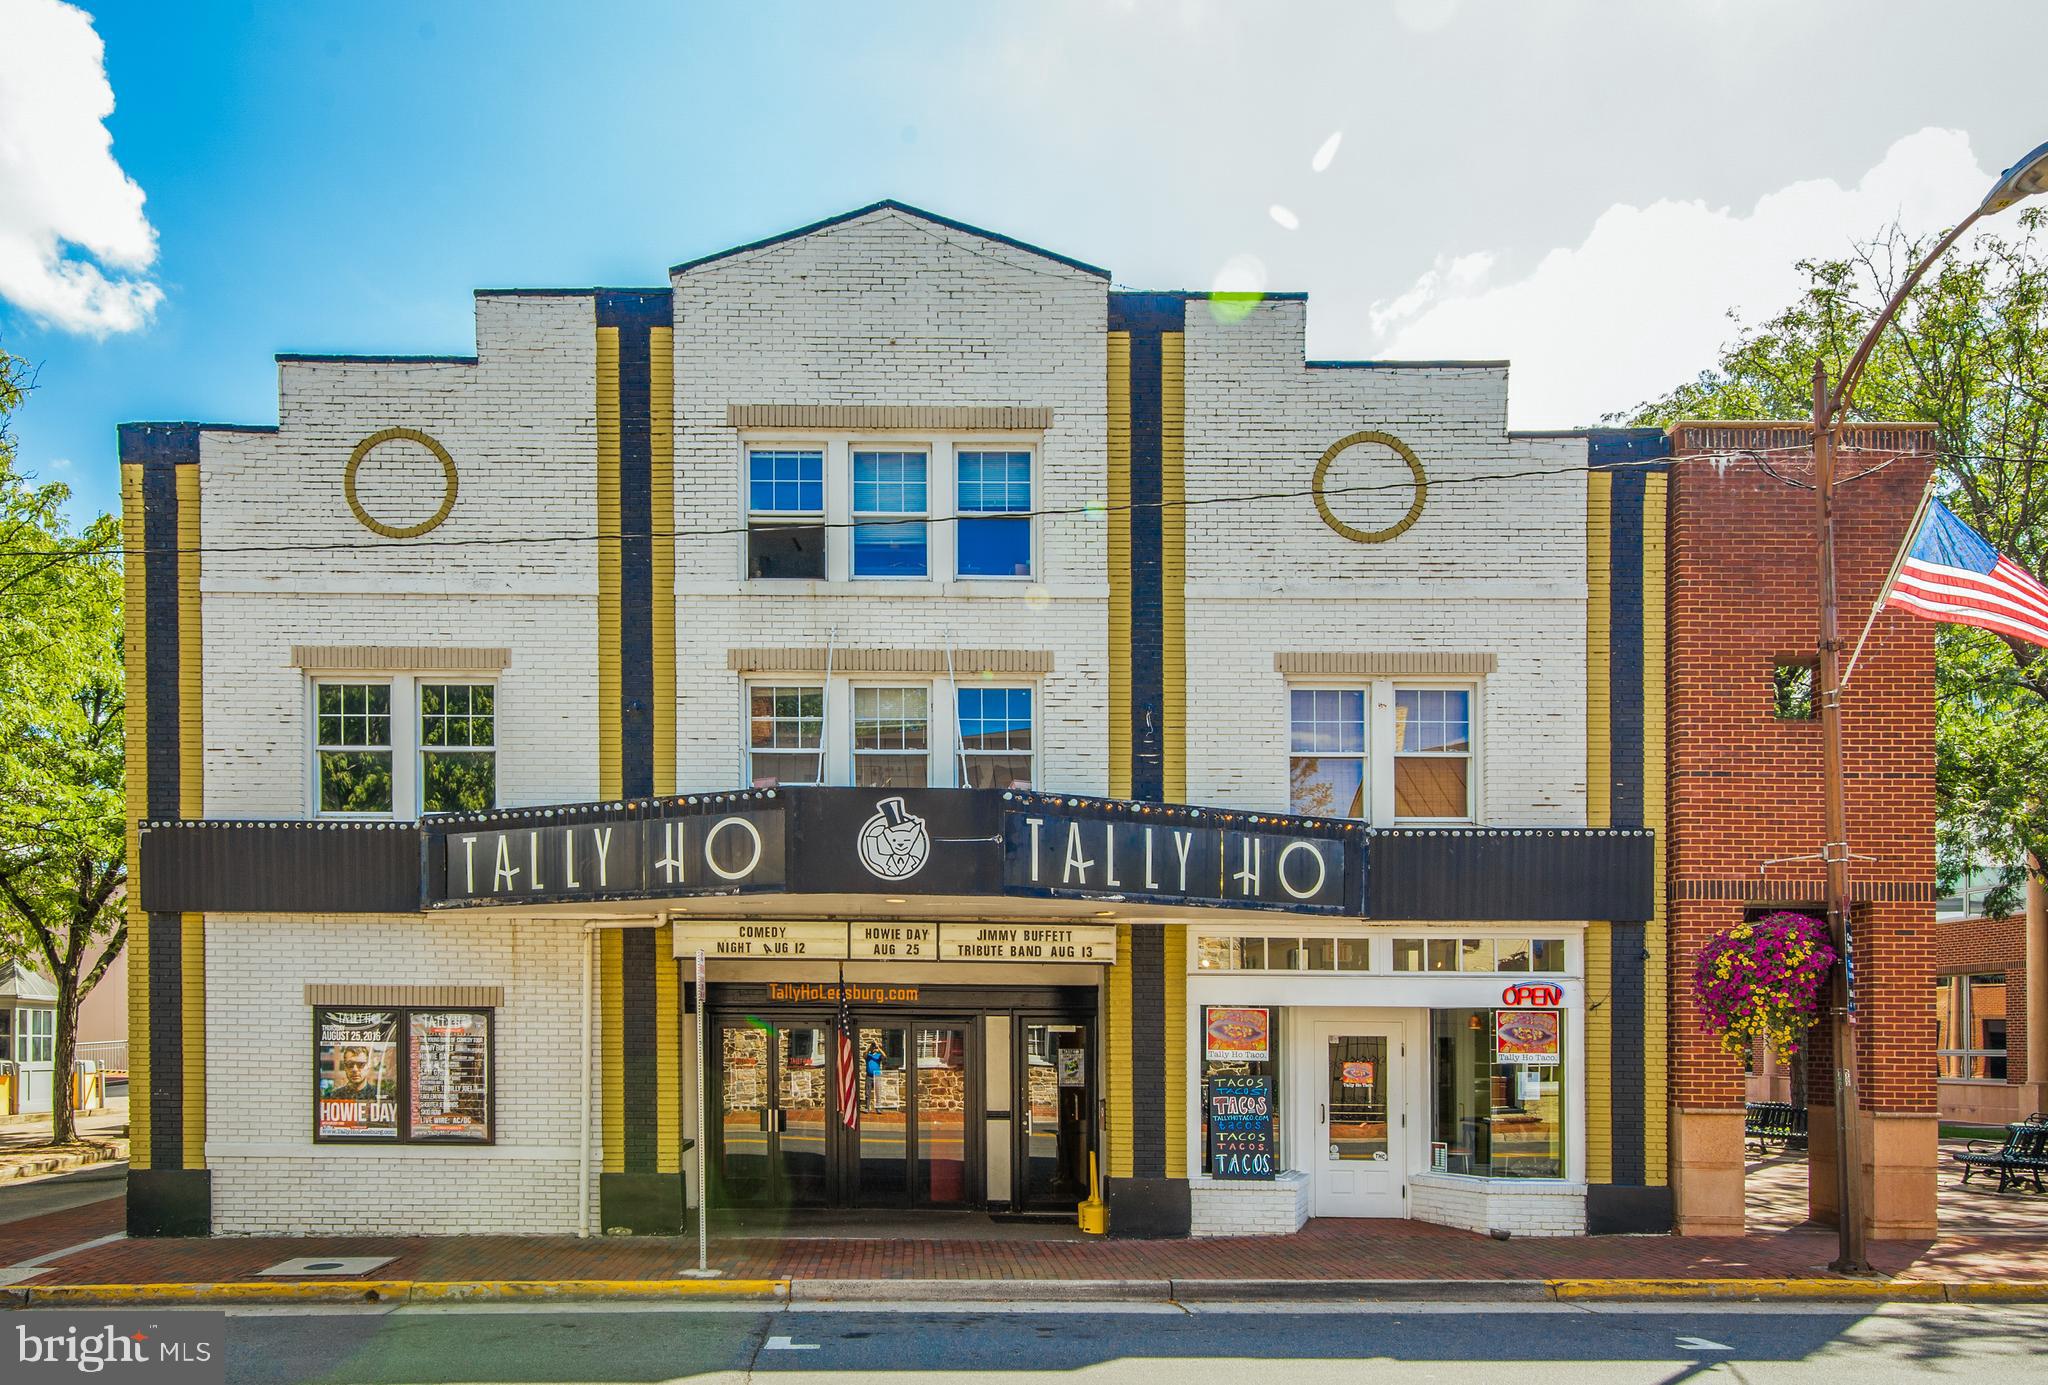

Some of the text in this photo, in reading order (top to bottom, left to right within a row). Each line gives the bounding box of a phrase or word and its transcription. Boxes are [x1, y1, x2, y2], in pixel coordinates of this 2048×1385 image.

[462, 817, 761, 894] TALLY HO
[1026, 818, 1326, 899] TALLY HO
[739, 926, 786, 938] COMEDY
[865, 927, 928, 940] HOWIE DAY
[976, 929, 1072, 942] JIMMY BUFFETT
[717, 941, 806, 954] NIGHT AUG 12
[873, 943, 920, 955] AUG 25
[957, 944, 1093, 958] TRIBUTE BAND AUG 13
[1502, 986, 1562, 1007] OPEN
[321, 1031, 350, 1041] AUGUST
[1499, 1053, 1520, 1062] Tally
[1214, 1078, 1264, 1088] TACOS
[1216, 1088, 1268, 1096] TACOS!
[1213, 1096, 1267, 1115] TACOS
[320, 1103, 398, 1122] HOWIE DAY
[1216, 1133, 1266, 1142] TACOS
